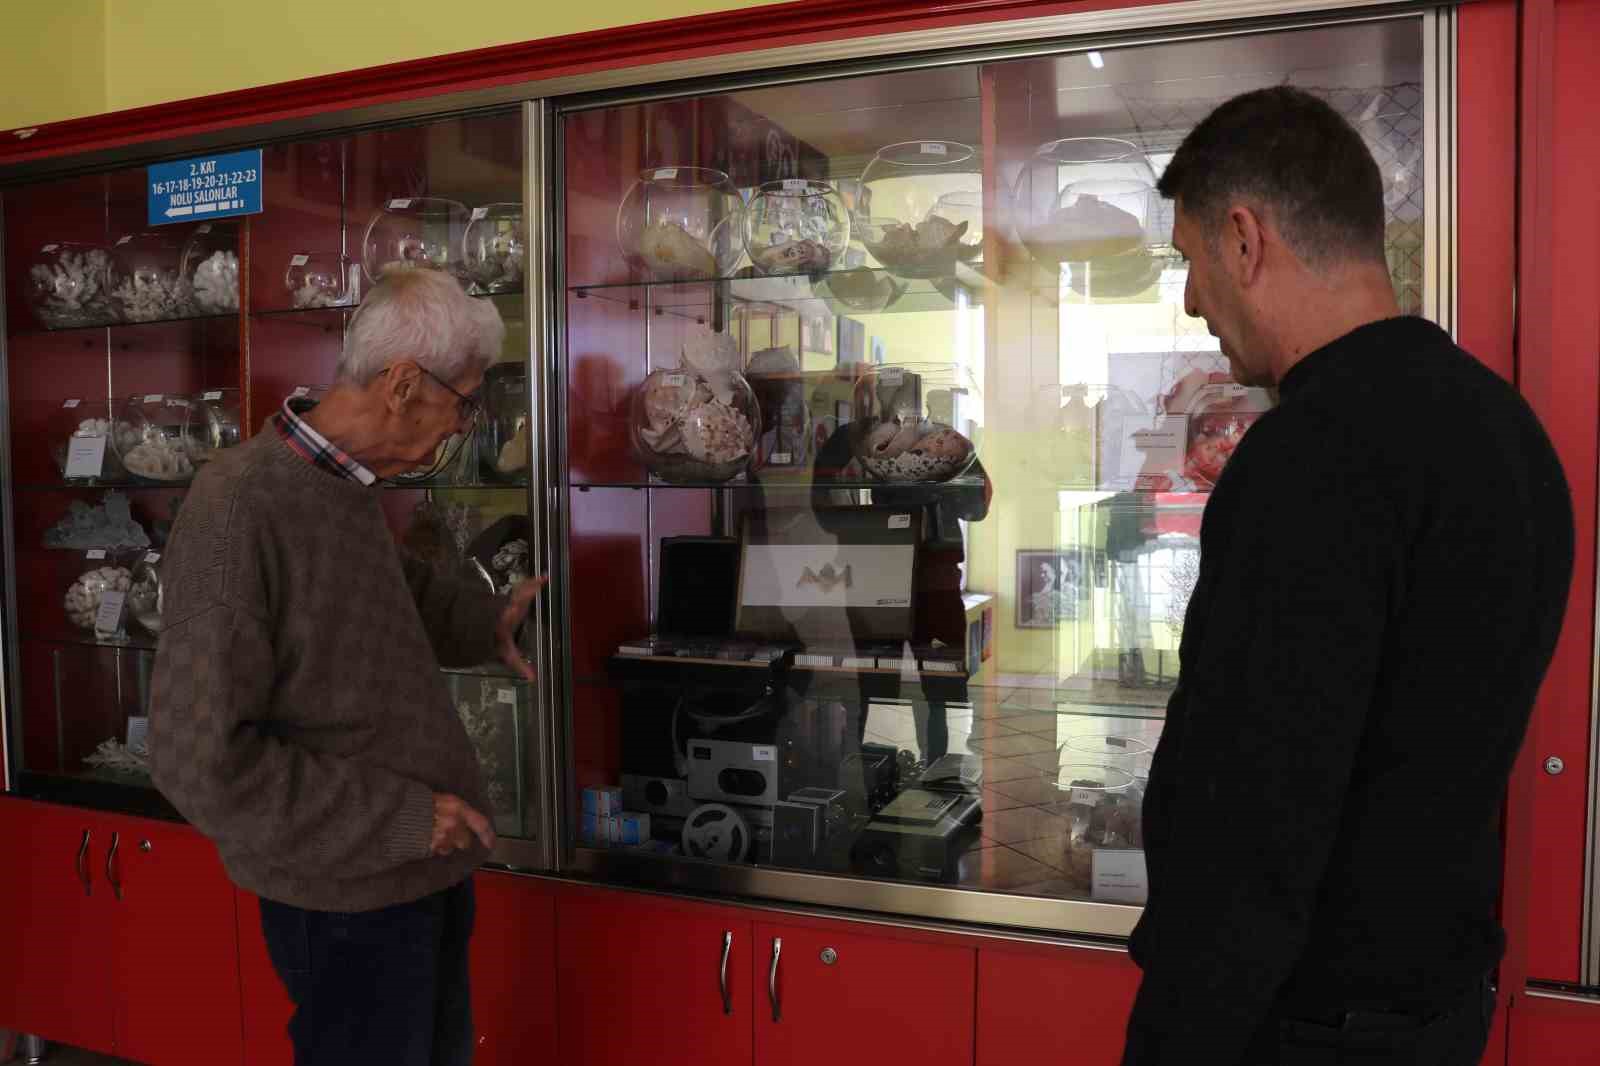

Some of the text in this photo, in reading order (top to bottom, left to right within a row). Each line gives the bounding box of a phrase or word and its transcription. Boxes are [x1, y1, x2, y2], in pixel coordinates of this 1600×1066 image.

[190, 160, 217, 176] 2. KAT
[152, 169, 257, 194] 16-17-18-19-20-21-22-23
[170, 186, 238, 206] NOLU SALONLAR
